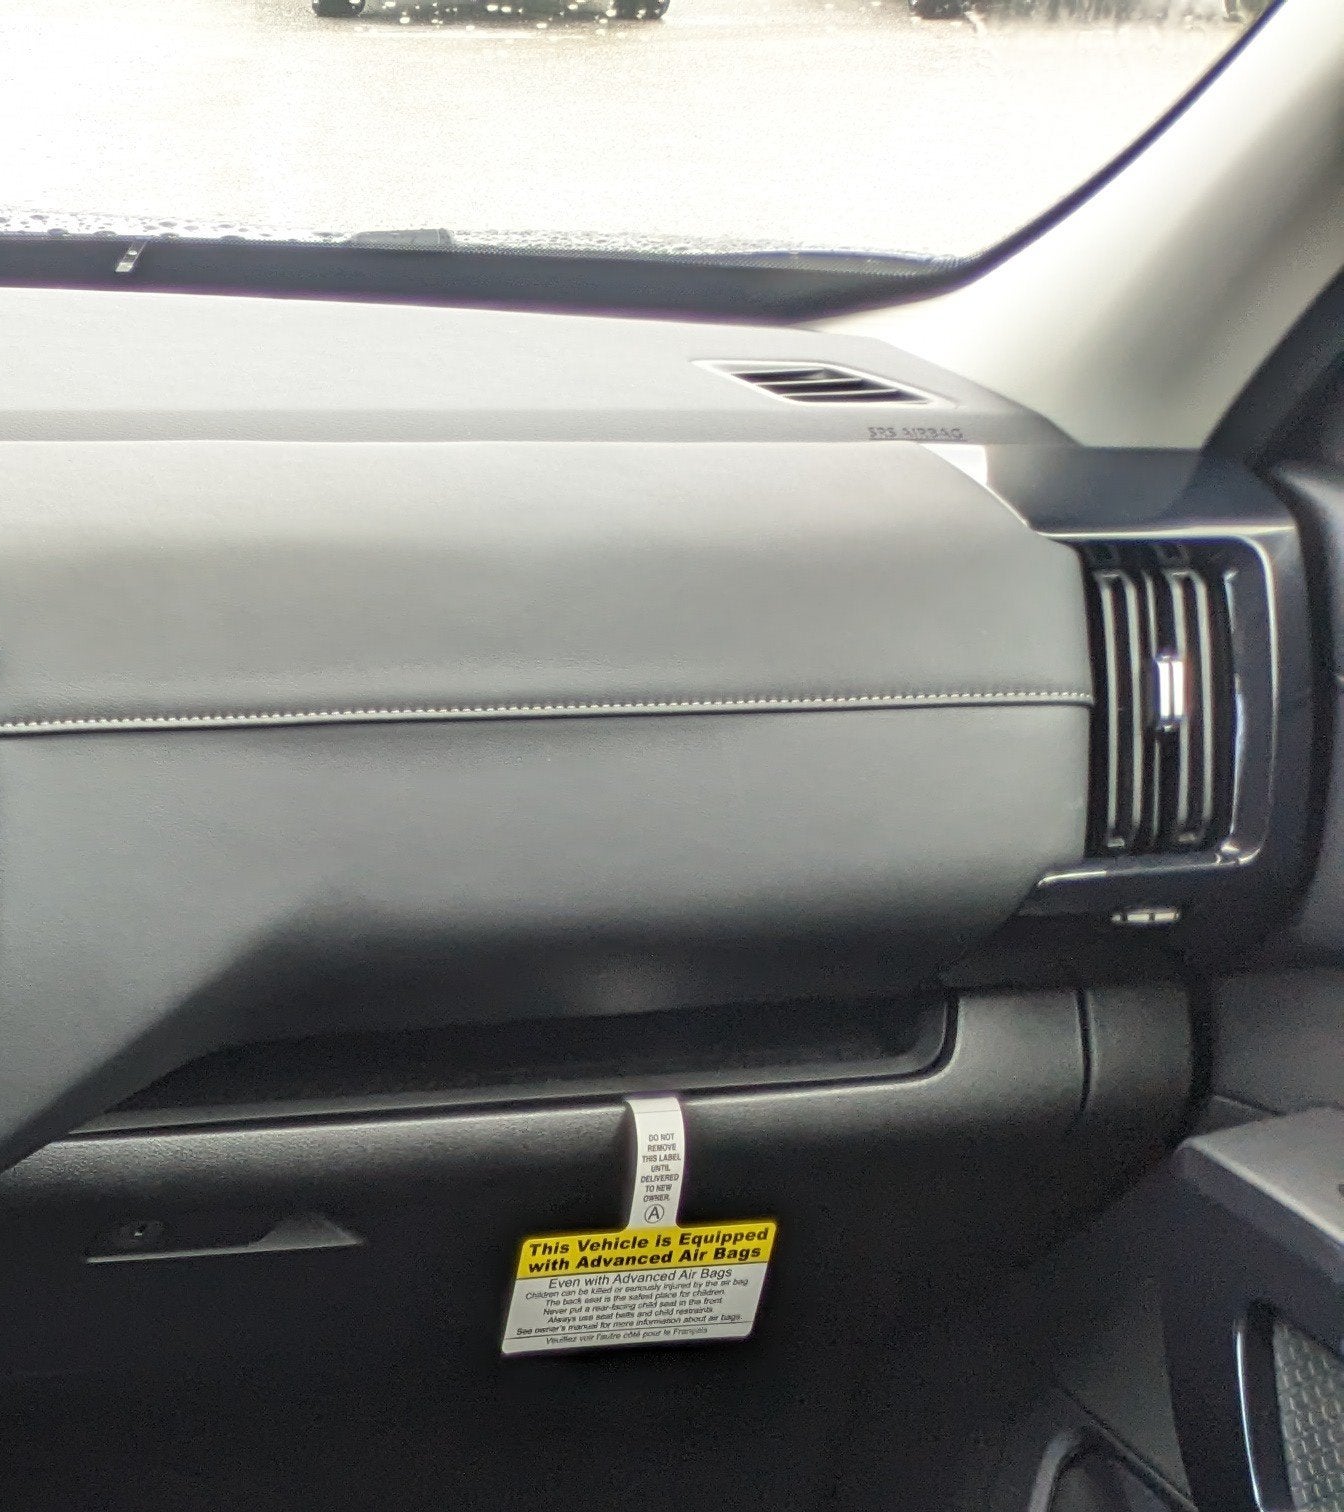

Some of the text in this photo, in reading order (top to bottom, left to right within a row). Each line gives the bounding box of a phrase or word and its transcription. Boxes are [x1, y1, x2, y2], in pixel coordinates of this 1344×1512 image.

[658, 1153, 682, 1162] LABEL
[640, 1173, 680, 1183] DELIVERED
[645, 1185, 655, 1193] TO
[647, 1206, 660, 1221] A
[528, 1227, 769, 1256] This Vehicle is Equipped
[528, 1247, 762, 1273] with Advanced Air Bags
[548, 1268, 733, 1289] Even with Advanced Air Bags
[525, 1289, 559, 1300] Children
[578, 1288, 589, 1296] be
[590, 1286, 612, 1295] killed
[692, 1281, 704, 1290] by
[562, 1298, 582, 1306] back
[654, 1292, 678, 1301] place
[543, 1308, 567, 1316] Never
